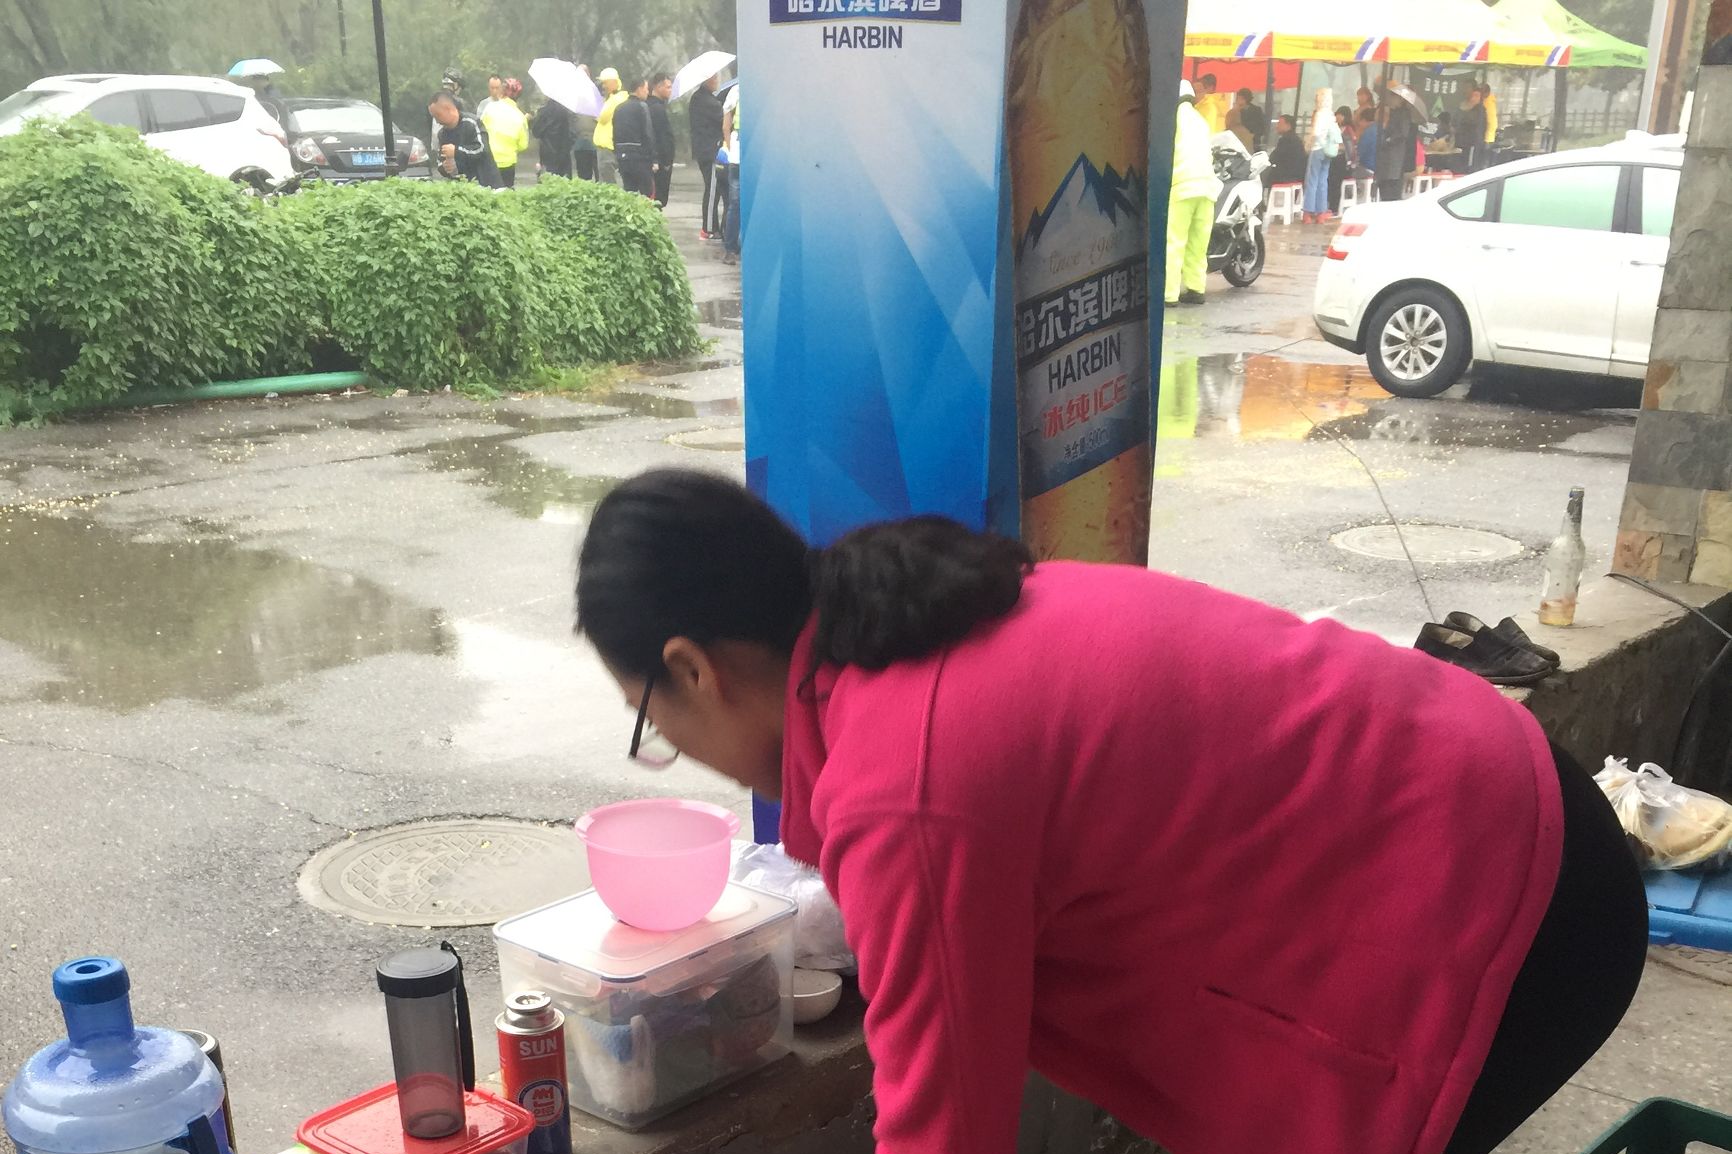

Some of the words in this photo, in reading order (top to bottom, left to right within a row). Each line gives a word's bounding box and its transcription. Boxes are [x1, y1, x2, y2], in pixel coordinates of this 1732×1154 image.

[822, 26, 903, 48] HARBIN
[1049, 332, 1121, 394] HARBIN
[1042, 392, 1090, 439] 冰纯
[1093, 373, 1128, 416] ICE
[519, 1036, 557, 1056] SUN
